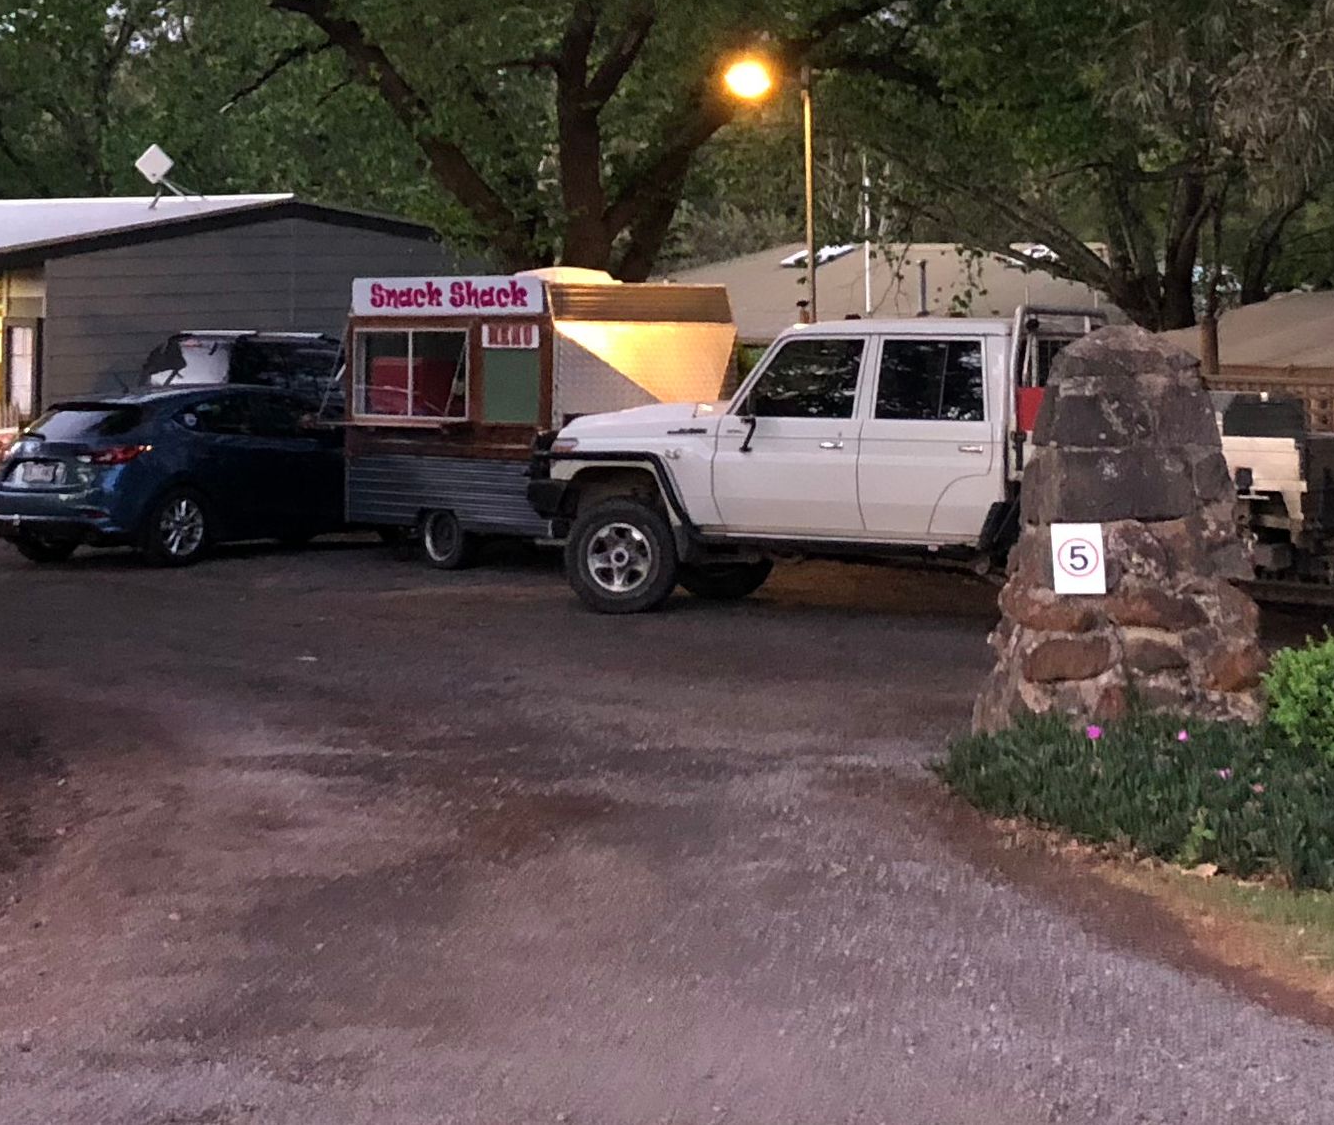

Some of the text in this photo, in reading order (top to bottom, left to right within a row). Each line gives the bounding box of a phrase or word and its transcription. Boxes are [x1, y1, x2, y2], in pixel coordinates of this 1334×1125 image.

[370, 280, 528, 308] Snack Shack
[1070, 546, 1088, 571] 5
